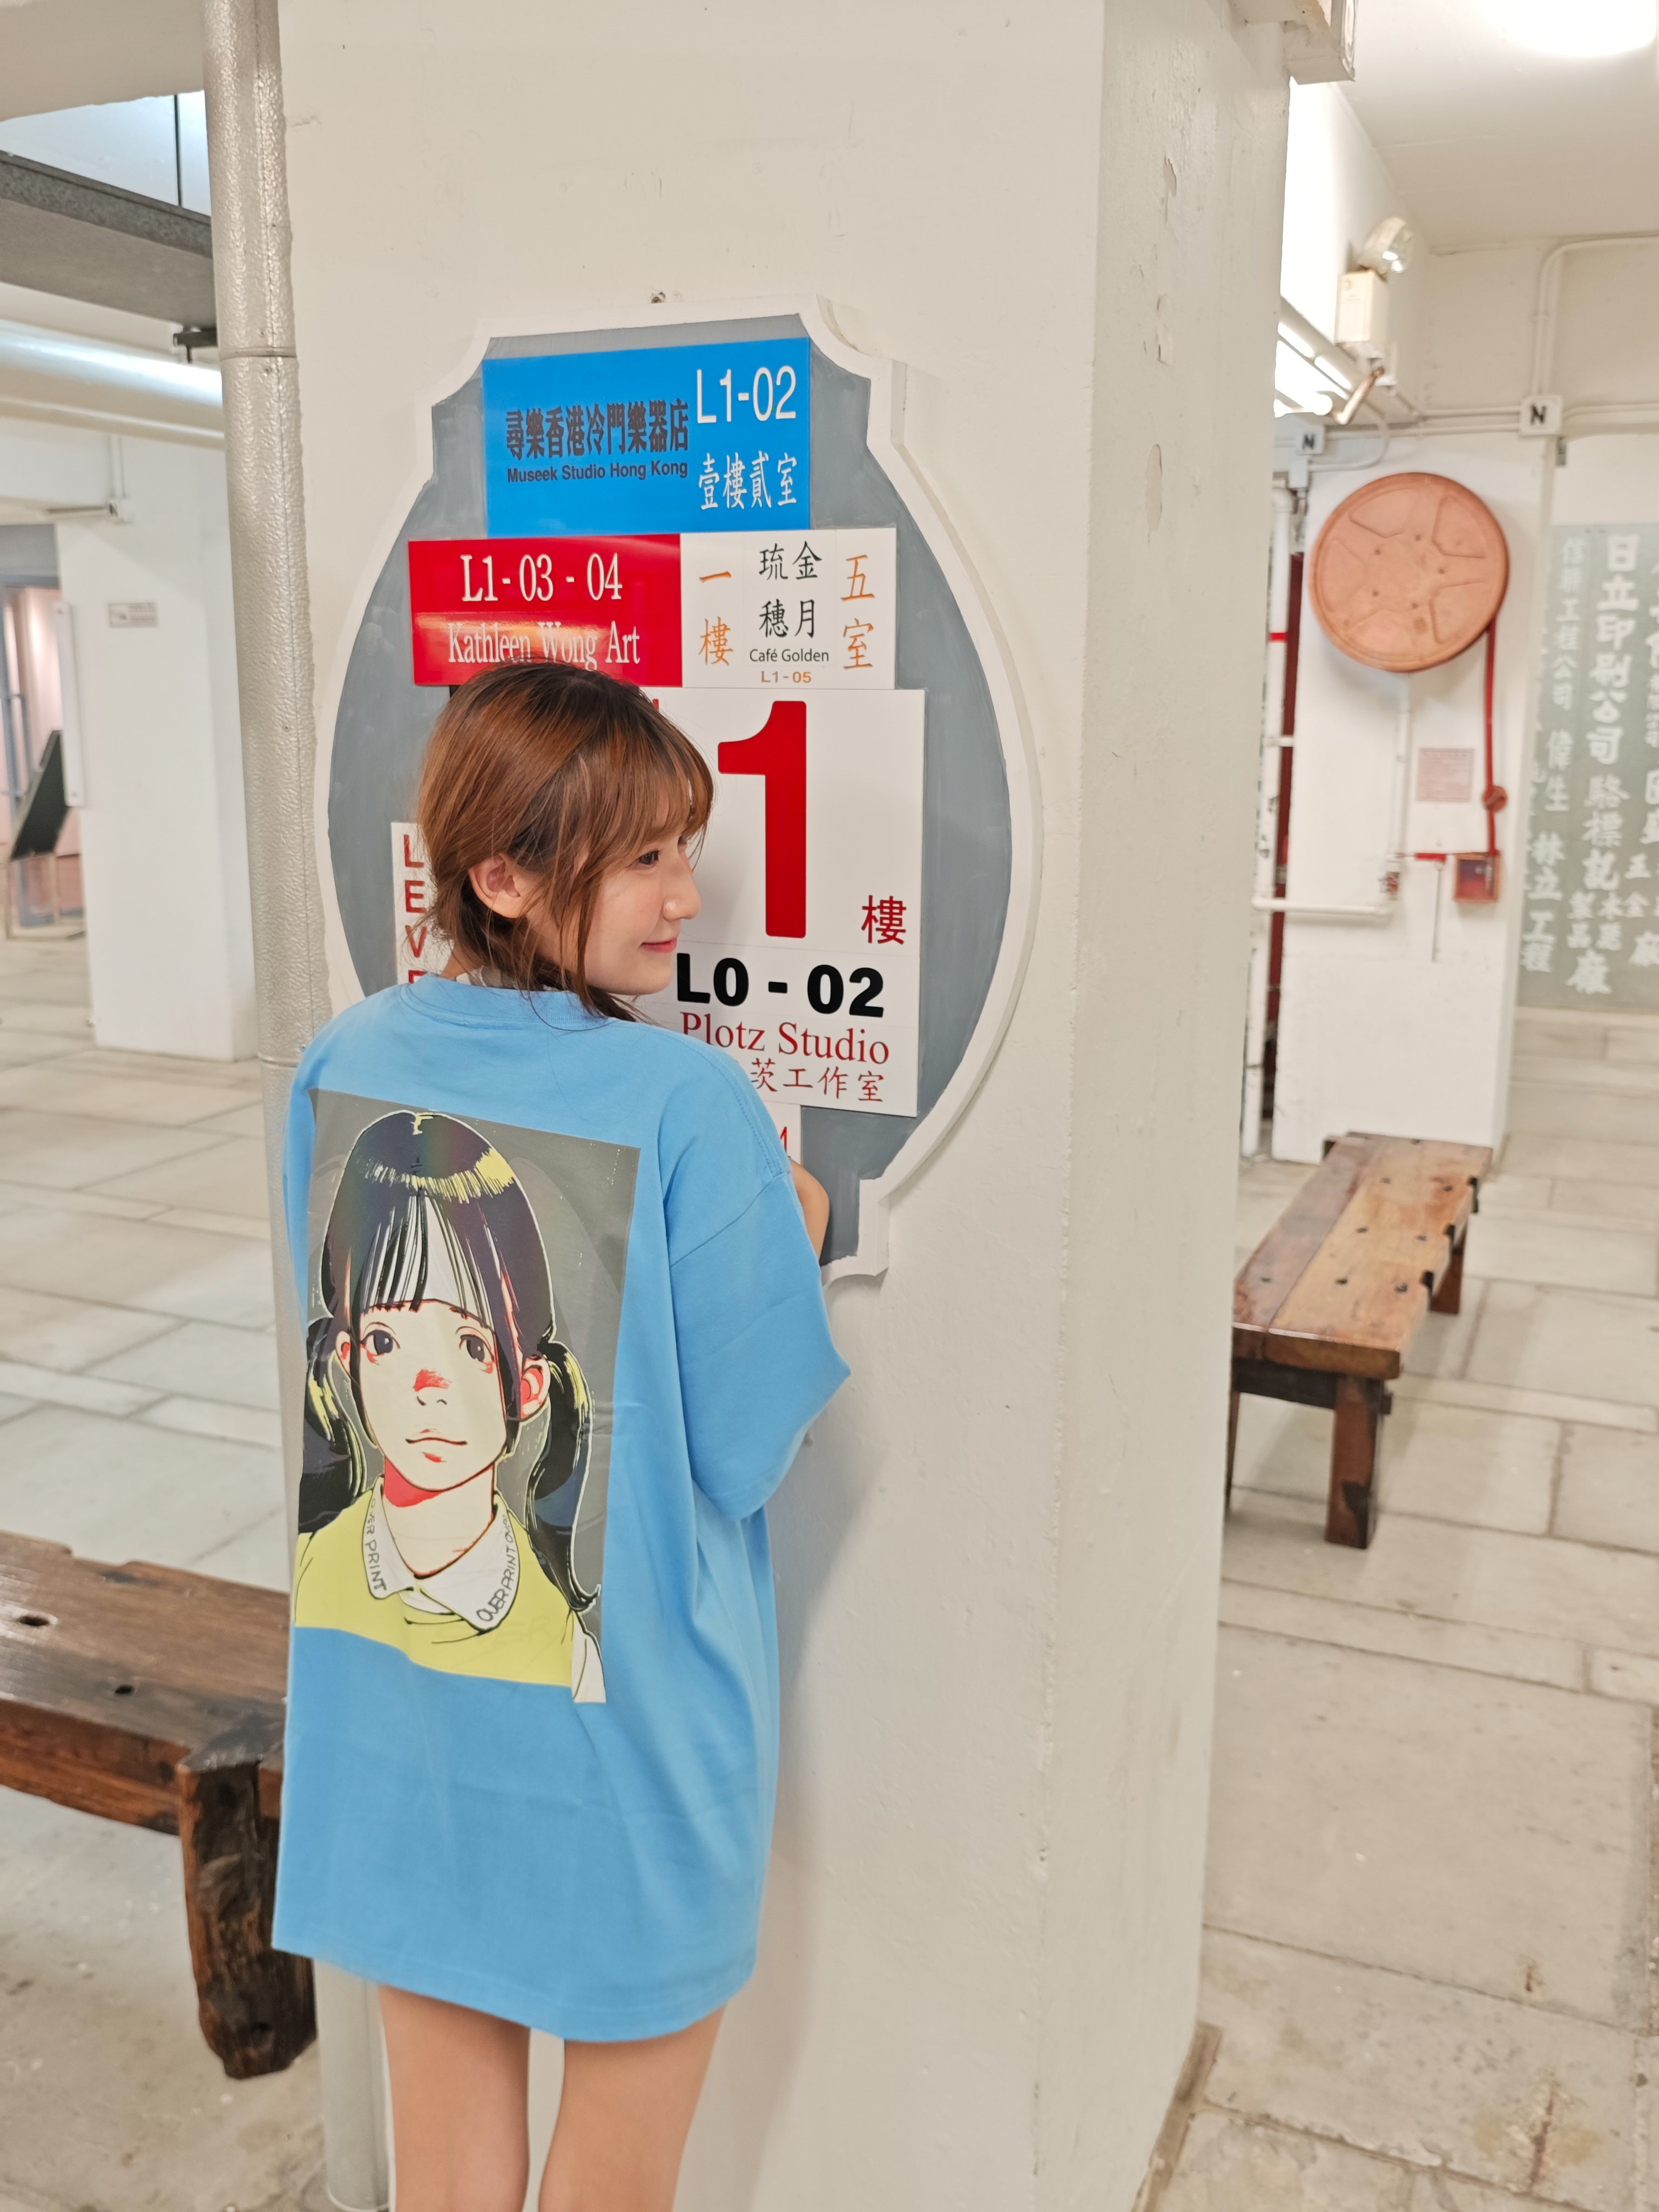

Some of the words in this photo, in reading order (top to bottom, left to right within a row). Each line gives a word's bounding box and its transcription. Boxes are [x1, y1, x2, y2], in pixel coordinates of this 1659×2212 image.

[697, 365, 797, 424] L1-02
[1529, 404, 1546, 426] N
[506, 397, 689, 461] 尋樂香港冷門樂器店
[1301, 433, 1315, 449] N
[507, 466, 558, 483] Museek
[562, 463, 606, 481] Studio
[610, 462, 646, 481] Hong
[651, 460, 688, 478] Kong
[699, 450, 798, 511] 壹樓貳室
[448, 621, 531, 664] Kathleen
[538, 621, 598, 672] Wong
[605, 621, 640, 665] Art
[750, 648, 778, 663] Café
[781, 648, 830, 664] Golden
[717, 700, 807, 939] 1
[861, 894, 908, 946] 樓
[680, 1011, 766, 1051] Plotz
[778, 1021, 890, 1065] Studio
[365, 1539, 387, 1591] PRINT
[500, 1547, 517, 1590] PRINT
